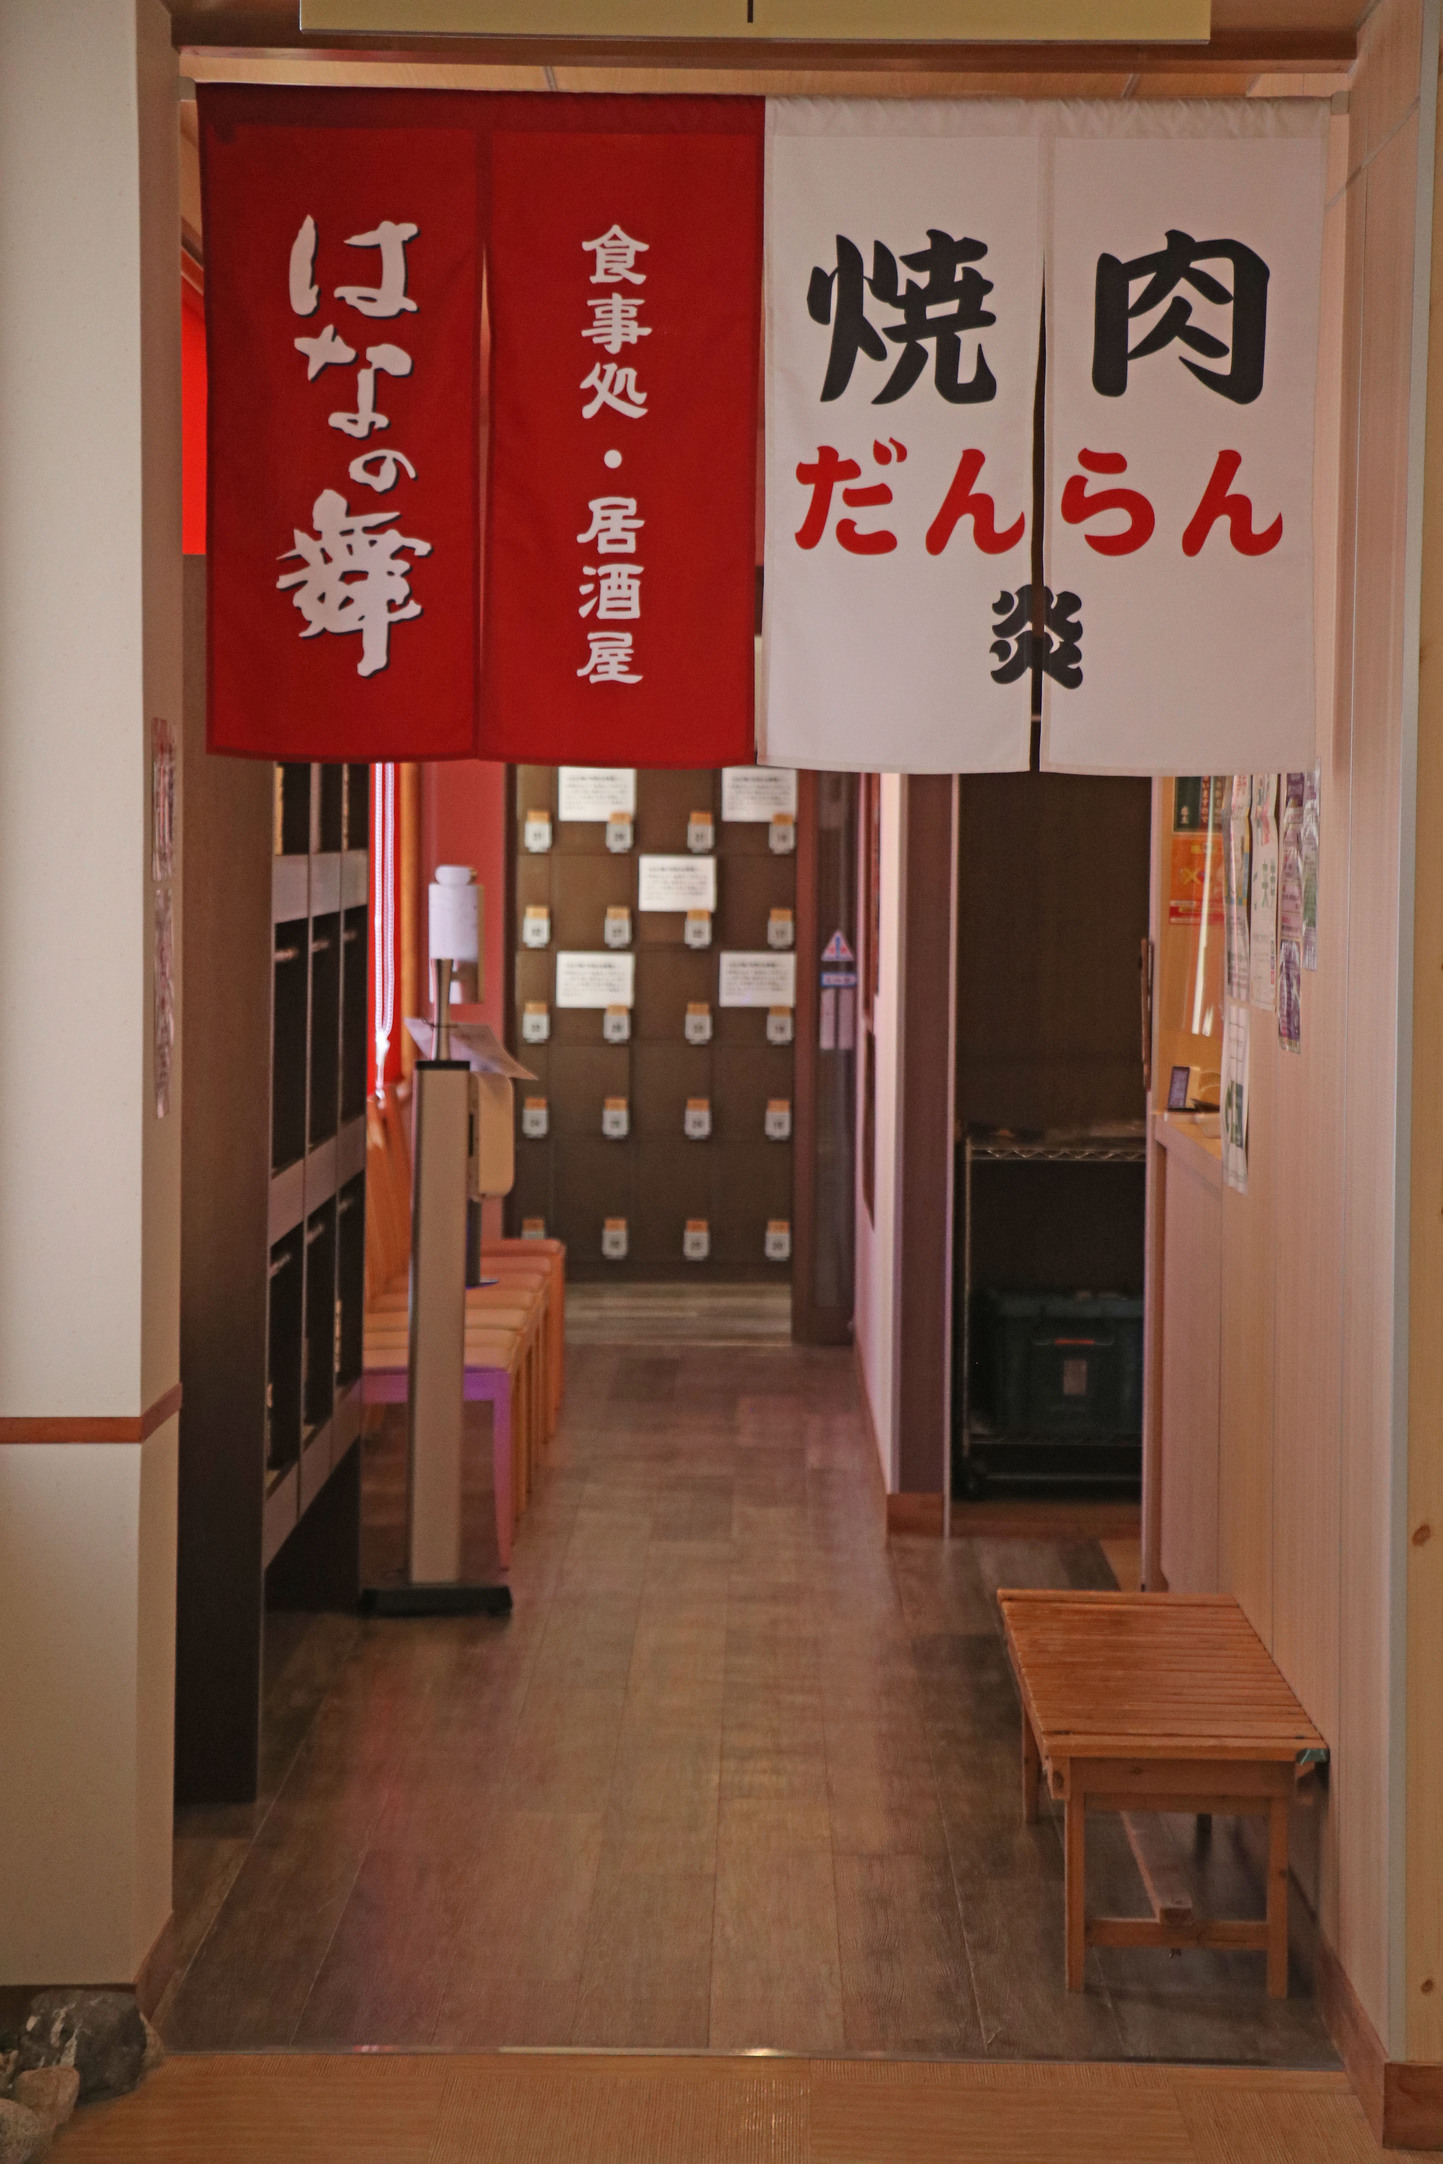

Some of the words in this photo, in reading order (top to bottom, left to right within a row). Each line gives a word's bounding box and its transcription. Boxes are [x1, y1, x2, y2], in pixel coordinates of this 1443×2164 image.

[807, 229, 1270, 404] 焼肉
[276, 214, 432, 677] はなの舞
[576, 224, 652, 684] 食事処・居酒屋
[795, 437, 1283, 556] だんらん
[989, 584, 1083, 689] 炎
